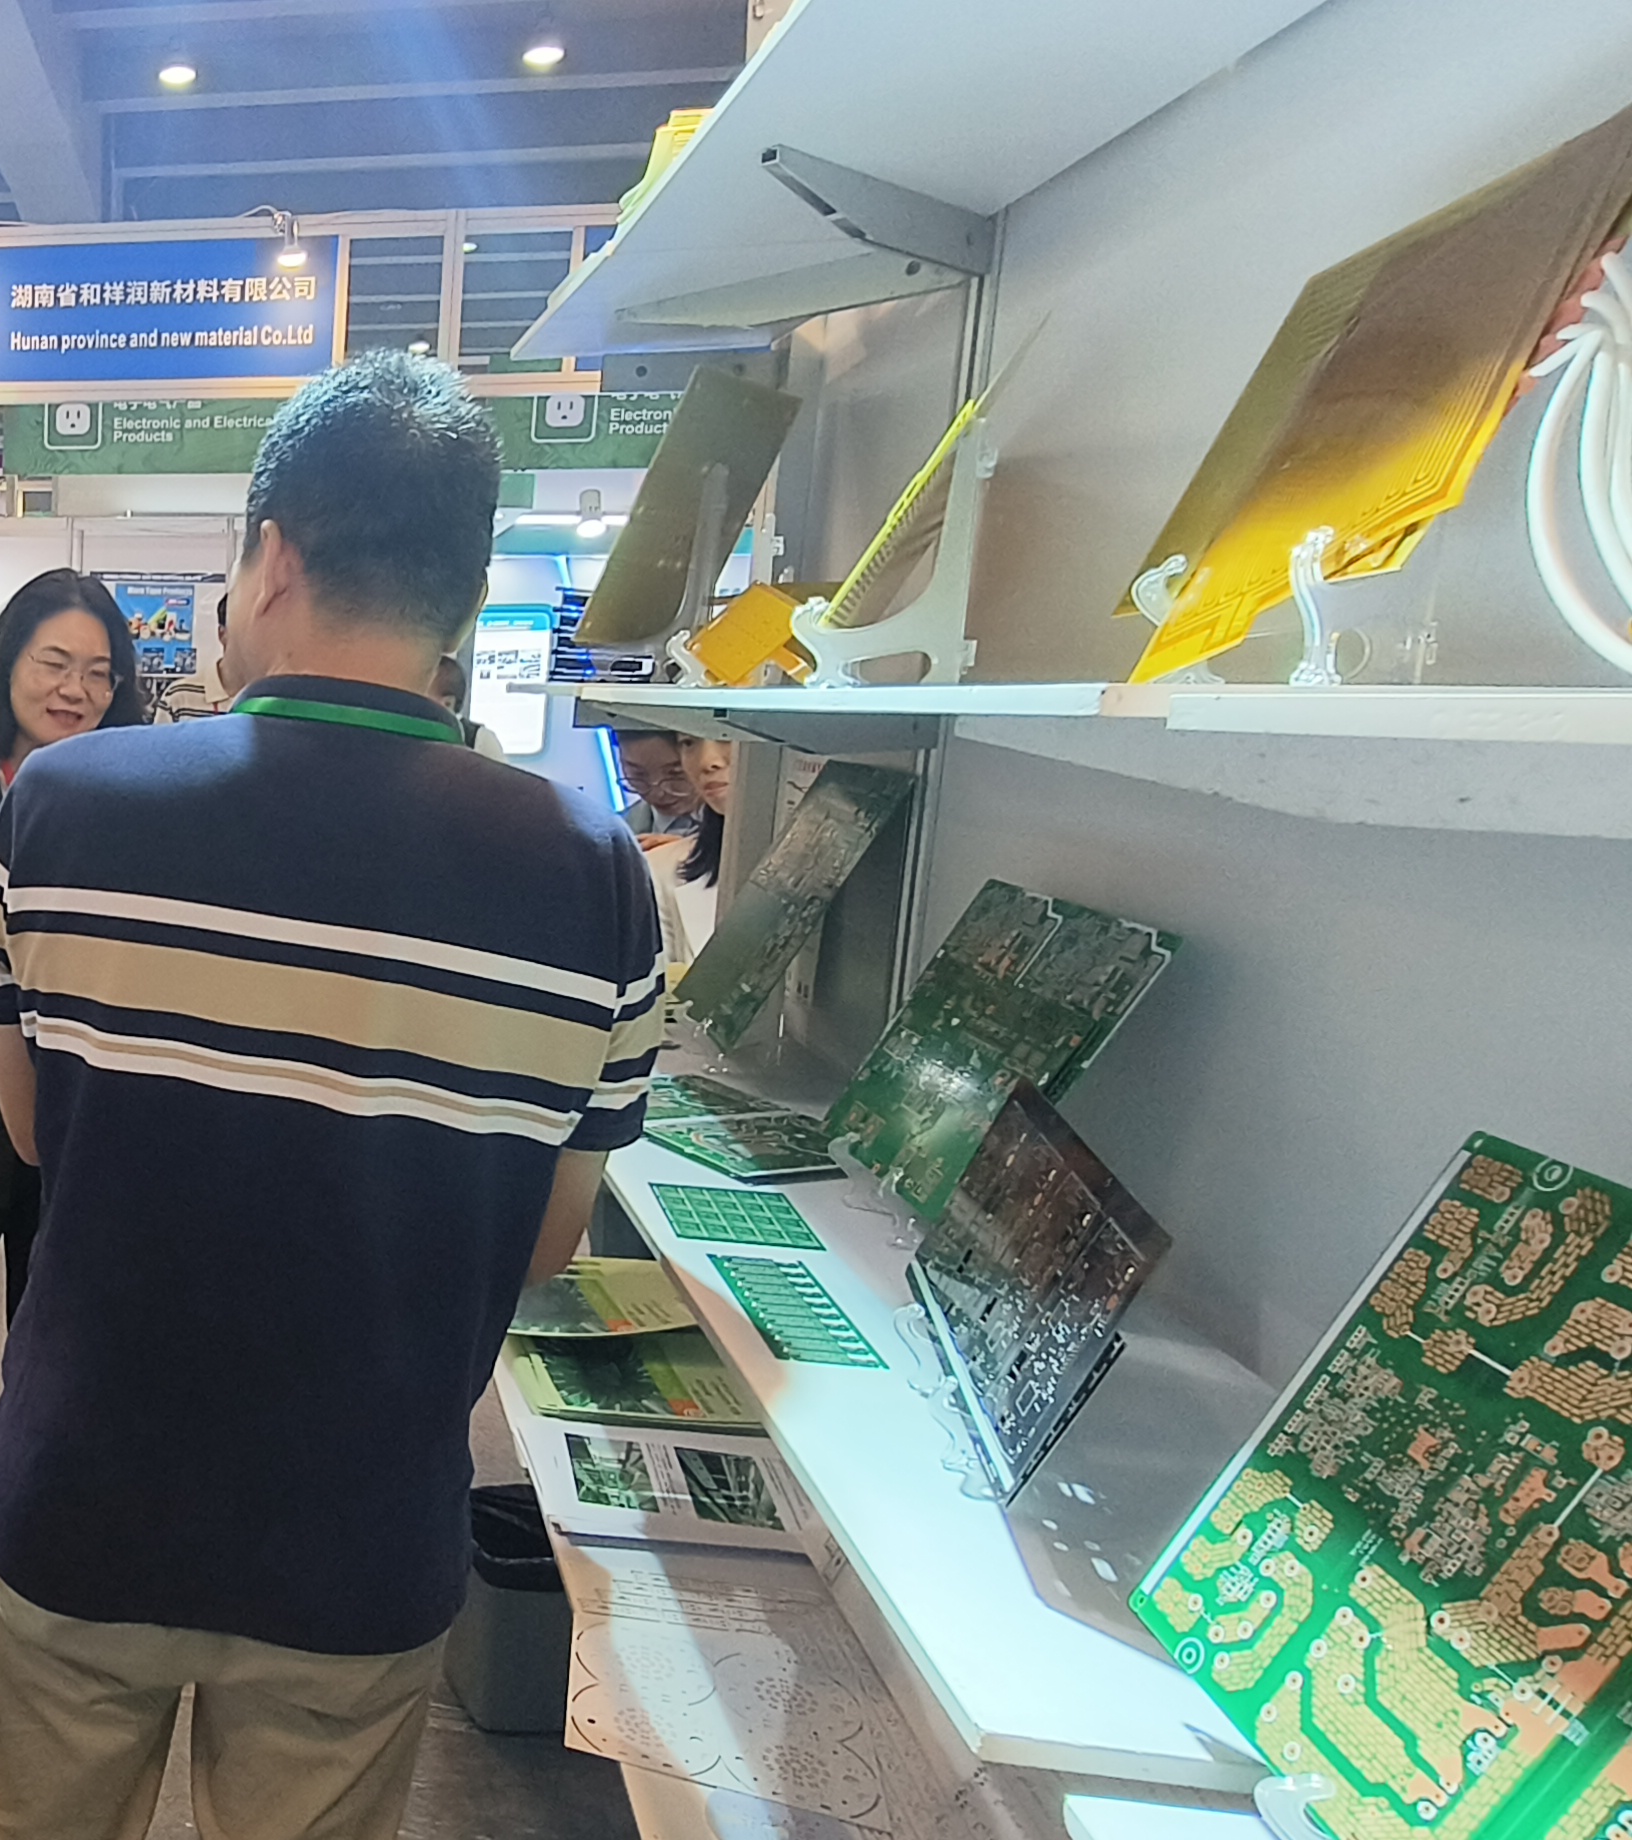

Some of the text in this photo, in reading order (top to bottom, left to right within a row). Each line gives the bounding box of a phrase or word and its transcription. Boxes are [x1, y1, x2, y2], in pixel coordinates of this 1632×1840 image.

[11, 276, 316, 309] 湖南省和祥润新材料有限公司
[10, 324, 313, 353] Hunan province and new material Co.Ltd
[113, 415, 275, 429] Electronic and Electrica
[608, 421, 668, 435] Product
[113, 430, 173, 442] Products
